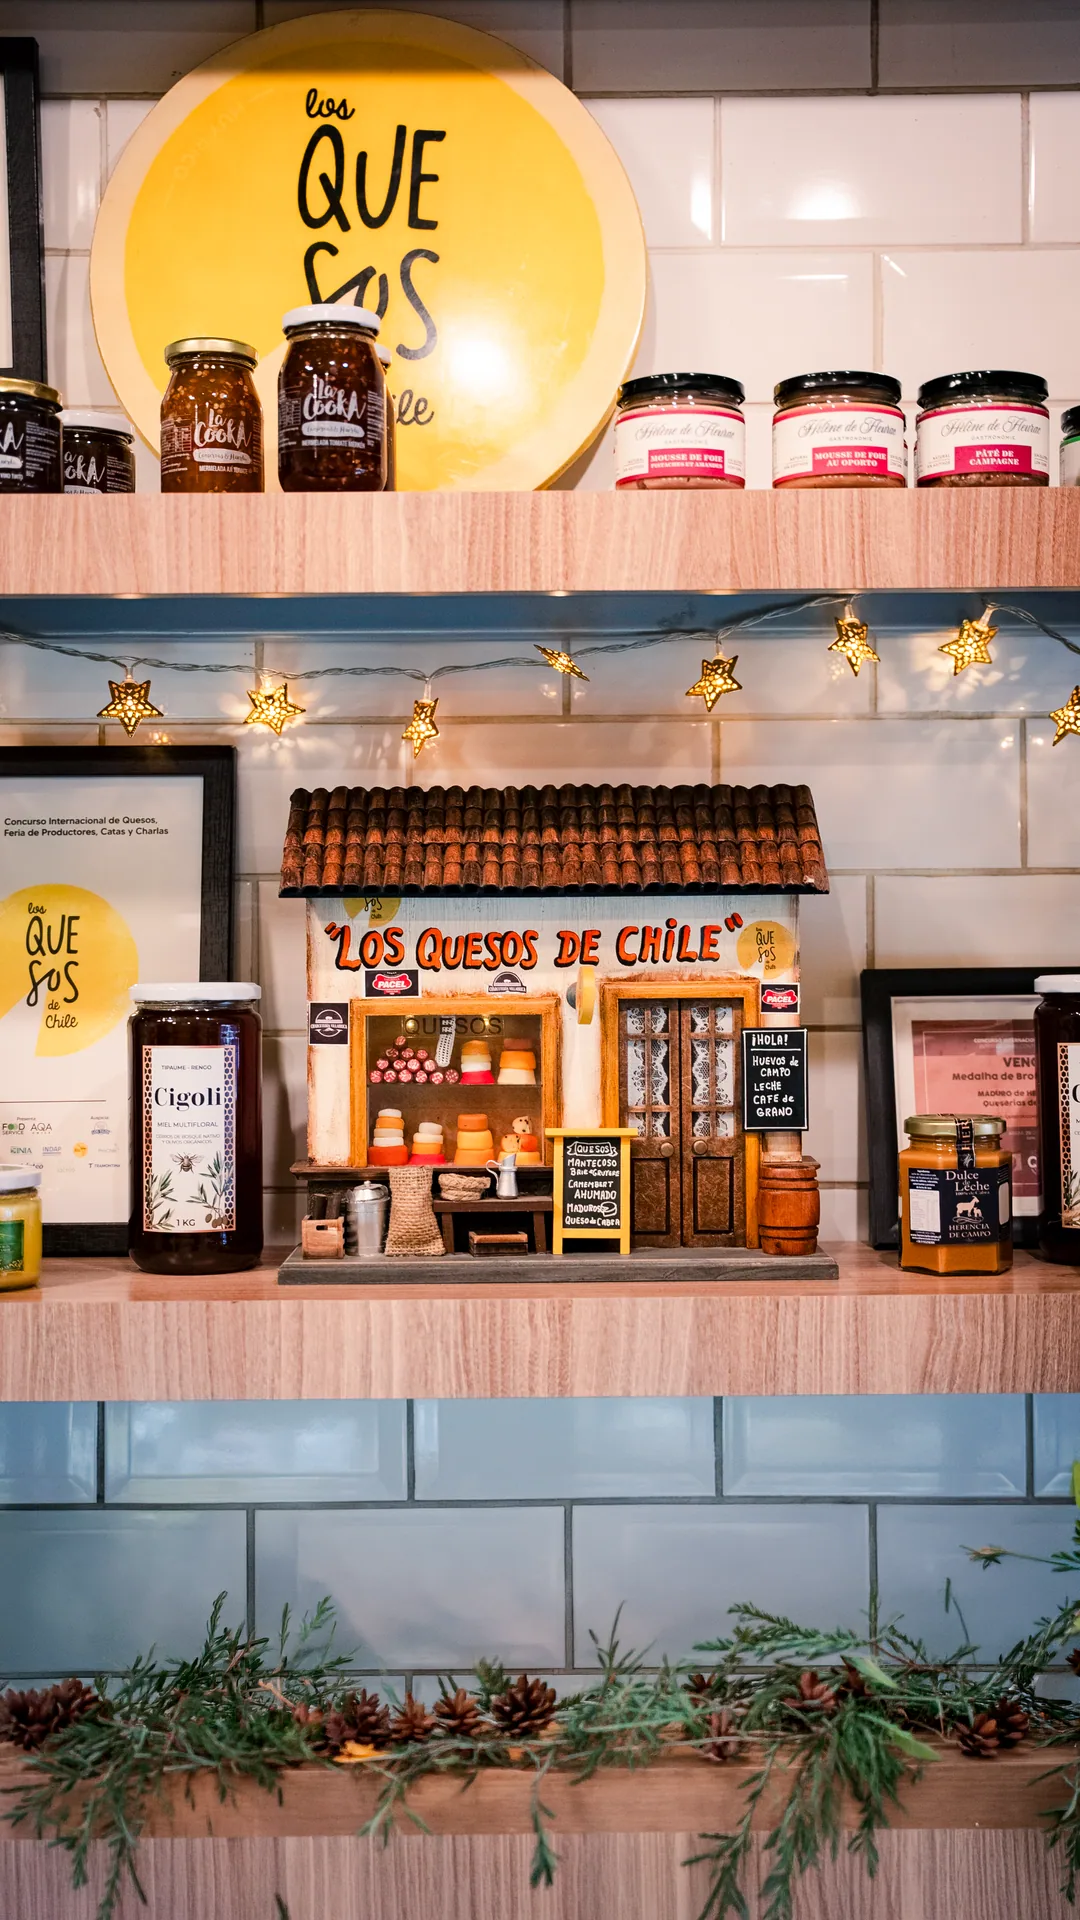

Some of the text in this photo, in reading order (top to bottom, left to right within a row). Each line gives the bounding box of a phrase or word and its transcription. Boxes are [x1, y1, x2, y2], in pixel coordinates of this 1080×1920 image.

[306, 88, 356, 120] los
[298, 124, 447, 233] QUE
[209, 408, 227, 428] La
[679, 423, 692, 435] de
[844, 419, 856, 432] de
[986, 418, 1000, 431] de
[650, 454, 688, 462] MOUSSE
[703, 454, 723, 463] FOIE
[814, 451, 887, 460] MOUSSE DE FOIE
[841, 459, 878, 467] OPORTO
[969, 458, 1019, 466] CAMPAGNE
[4, 818, 47, 826] Concurso
[48, 817, 107, 825] Internacional
[122, 816, 158, 825] Quesos,
[4, 827, 169, 837] Feria de Productores, Catas y Charlas
[28, 902, 47, 914] los
[26, 914, 80, 956] QUE
[756, 931, 775, 946] QUE
[416, 927, 539, 972] QUESOS
[553, 930, 602, 968] DE
[757, 946, 776, 963] SOS
[26, 960, 79, 1007] SOS
[378, 980, 406, 988] PACEL
[766, 995, 793, 1003] PACEL
[48, 1000, 60, 1010] de
[45, 1014, 78, 1029] Chile
[405, 1018, 502, 1035] QUESOS
[752, 1034, 788, 1046] ¡HOLA!
[752, 1056, 799, 1067] HUEVOS de
[760, 1067, 791, 1077] CAMPO
[952, 1072, 998, 1080] Medalha
[1000, 1072, 1014, 1080] de
[754, 1081, 782, 1091] LECHE
[154, 1087, 222, 1111] Cigoli
[753, 1094, 795, 1104] CAFE de
[756, 1107, 793, 1117] GRANO
[31, 1123, 52, 1131] AQA
[577, 1145, 610, 1153] QUESOS
[567, 1158, 617, 1168] MANTECOSO
[946, 1171, 979, 1180] Dulce
[568, 1180, 614, 1188] CAMEMBERT
[955, 1181, 990, 1191] Leche
[574, 1189, 617, 1200] AHUMADO
[182, 1219, 196, 1227] KG
[565, 1216, 589, 1225] QUESO
